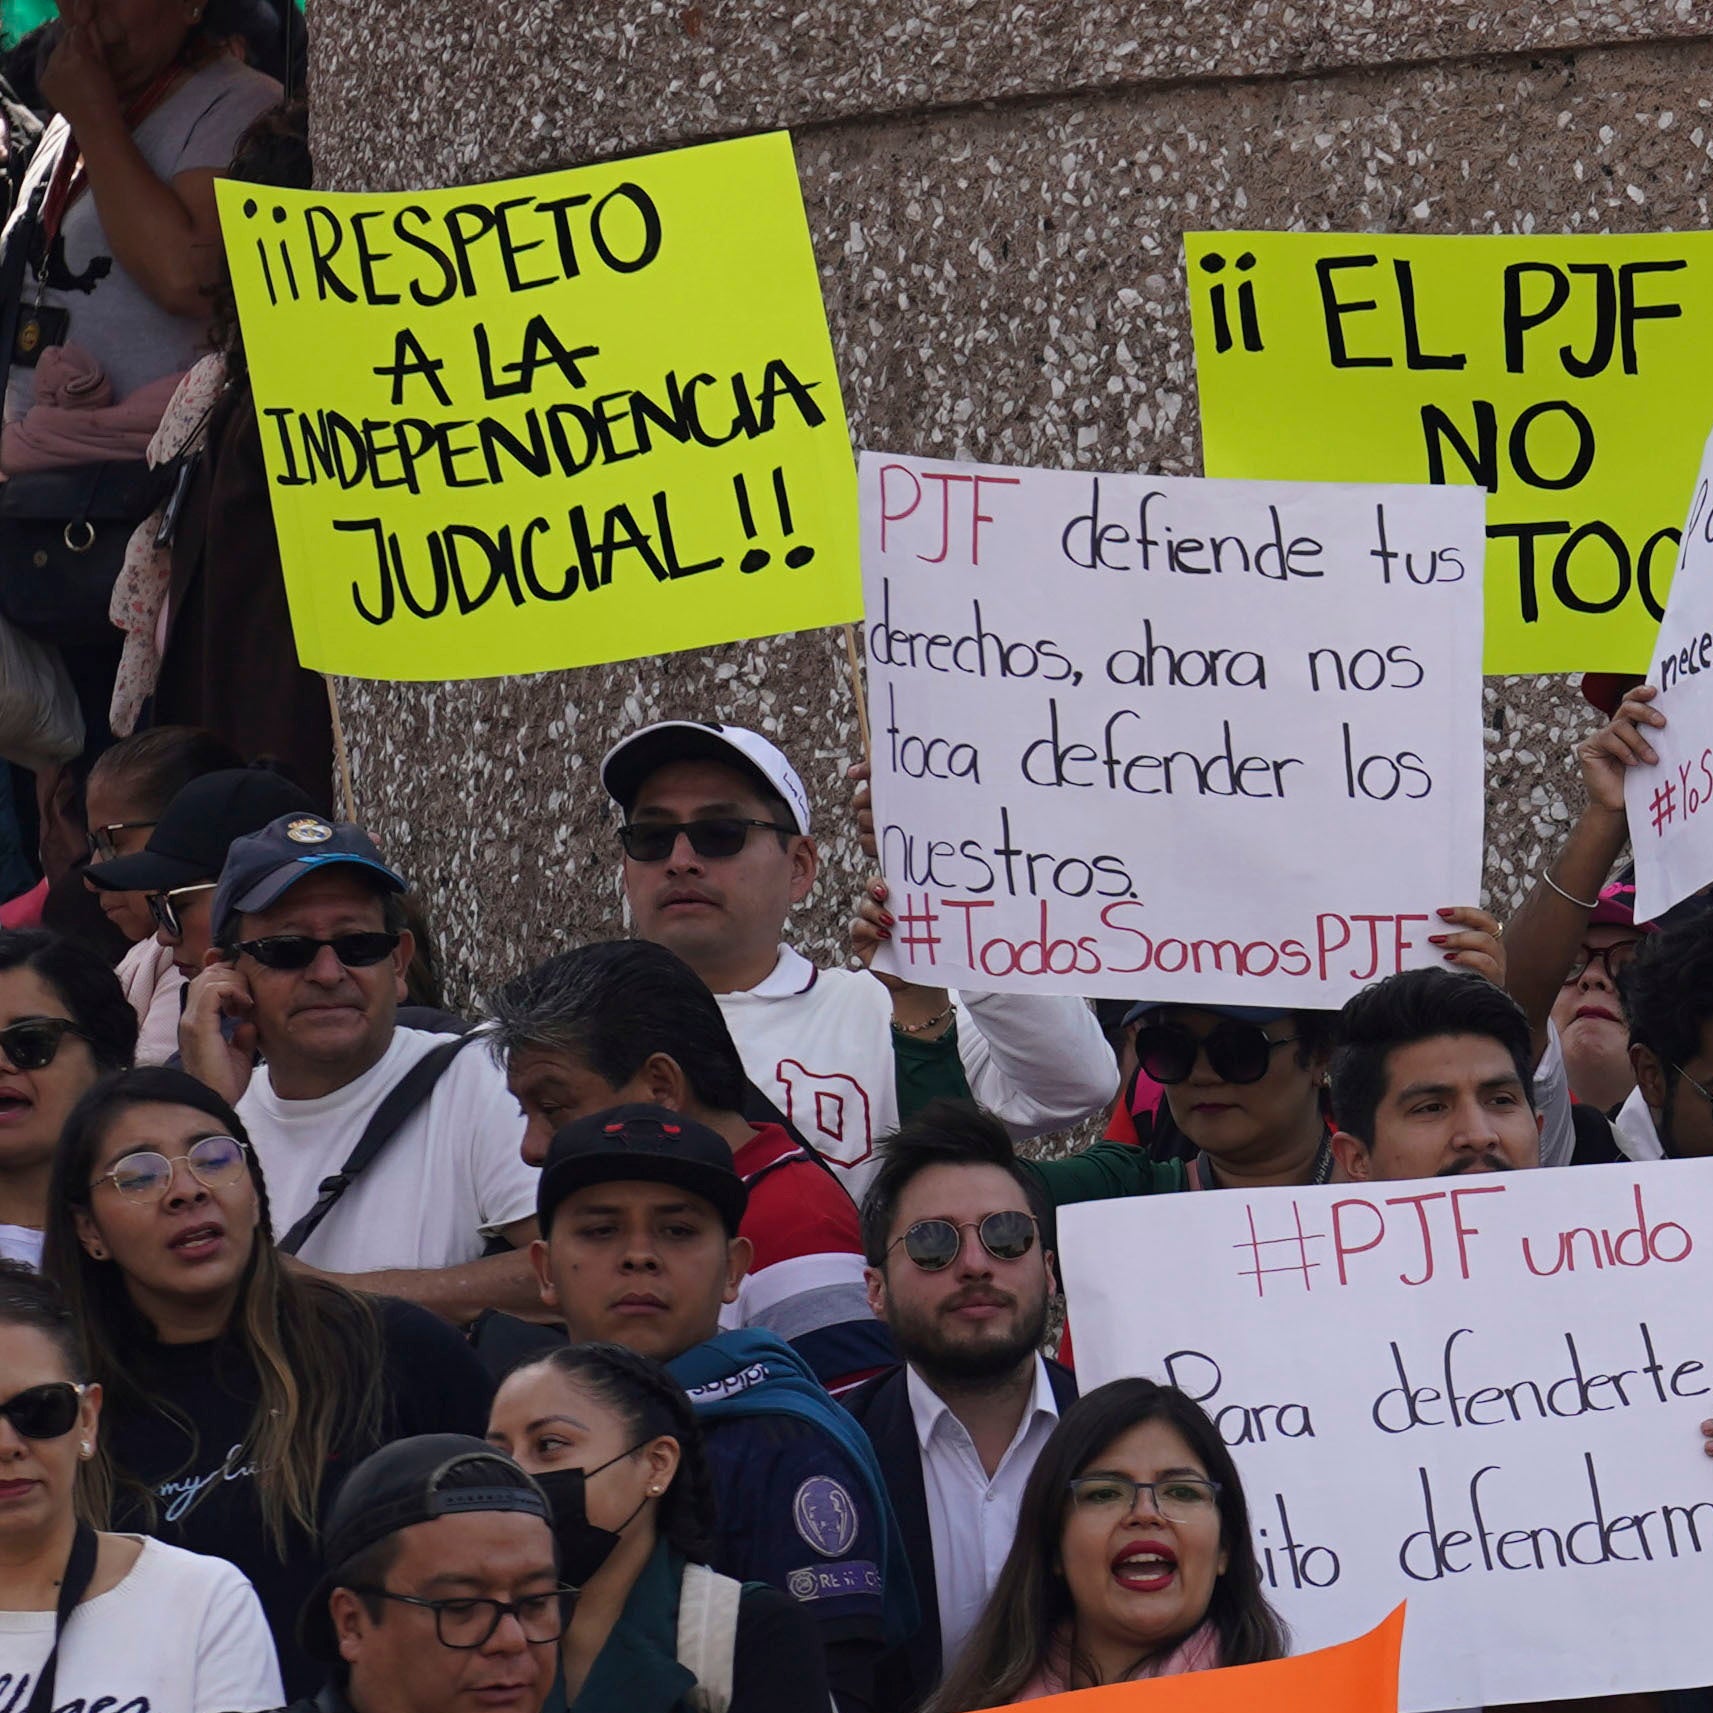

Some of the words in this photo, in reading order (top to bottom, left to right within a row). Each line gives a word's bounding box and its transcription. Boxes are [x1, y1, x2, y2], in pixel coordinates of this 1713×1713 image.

[373, 328, 450, 406] A
[473, 314, 599, 397] LA
[1315, 255, 1465, 371] EL
[1504, 260, 1688, 377] PJF
[264, 358, 823, 495] INDEPENDENCIA
[1421, 400, 1595, 494] NO
[879, 464, 1020, 565] PJF
[1062, 477, 1326, 580] defiende
[1370, 504, 1466, 584] tus
[869, 578, 1083, 687] derechos,
[1106, 619, 1268, 691] ahora
[1308, 644, 1424, 691] nos
[886, 682, 979, 784] toca
[1021, 698, 1305, 798] defender
[1344, 722, 1433, 799] los
[881, 807, 1140, 899] nuestros.
[898, 892, 1429, 981] #TodosSomosPJF
[1232, 1185, 1506, 1298] #PJF
[1522, 1184, 1694, 1278] unido
[1164, 1350, 1314, 1447] Para
